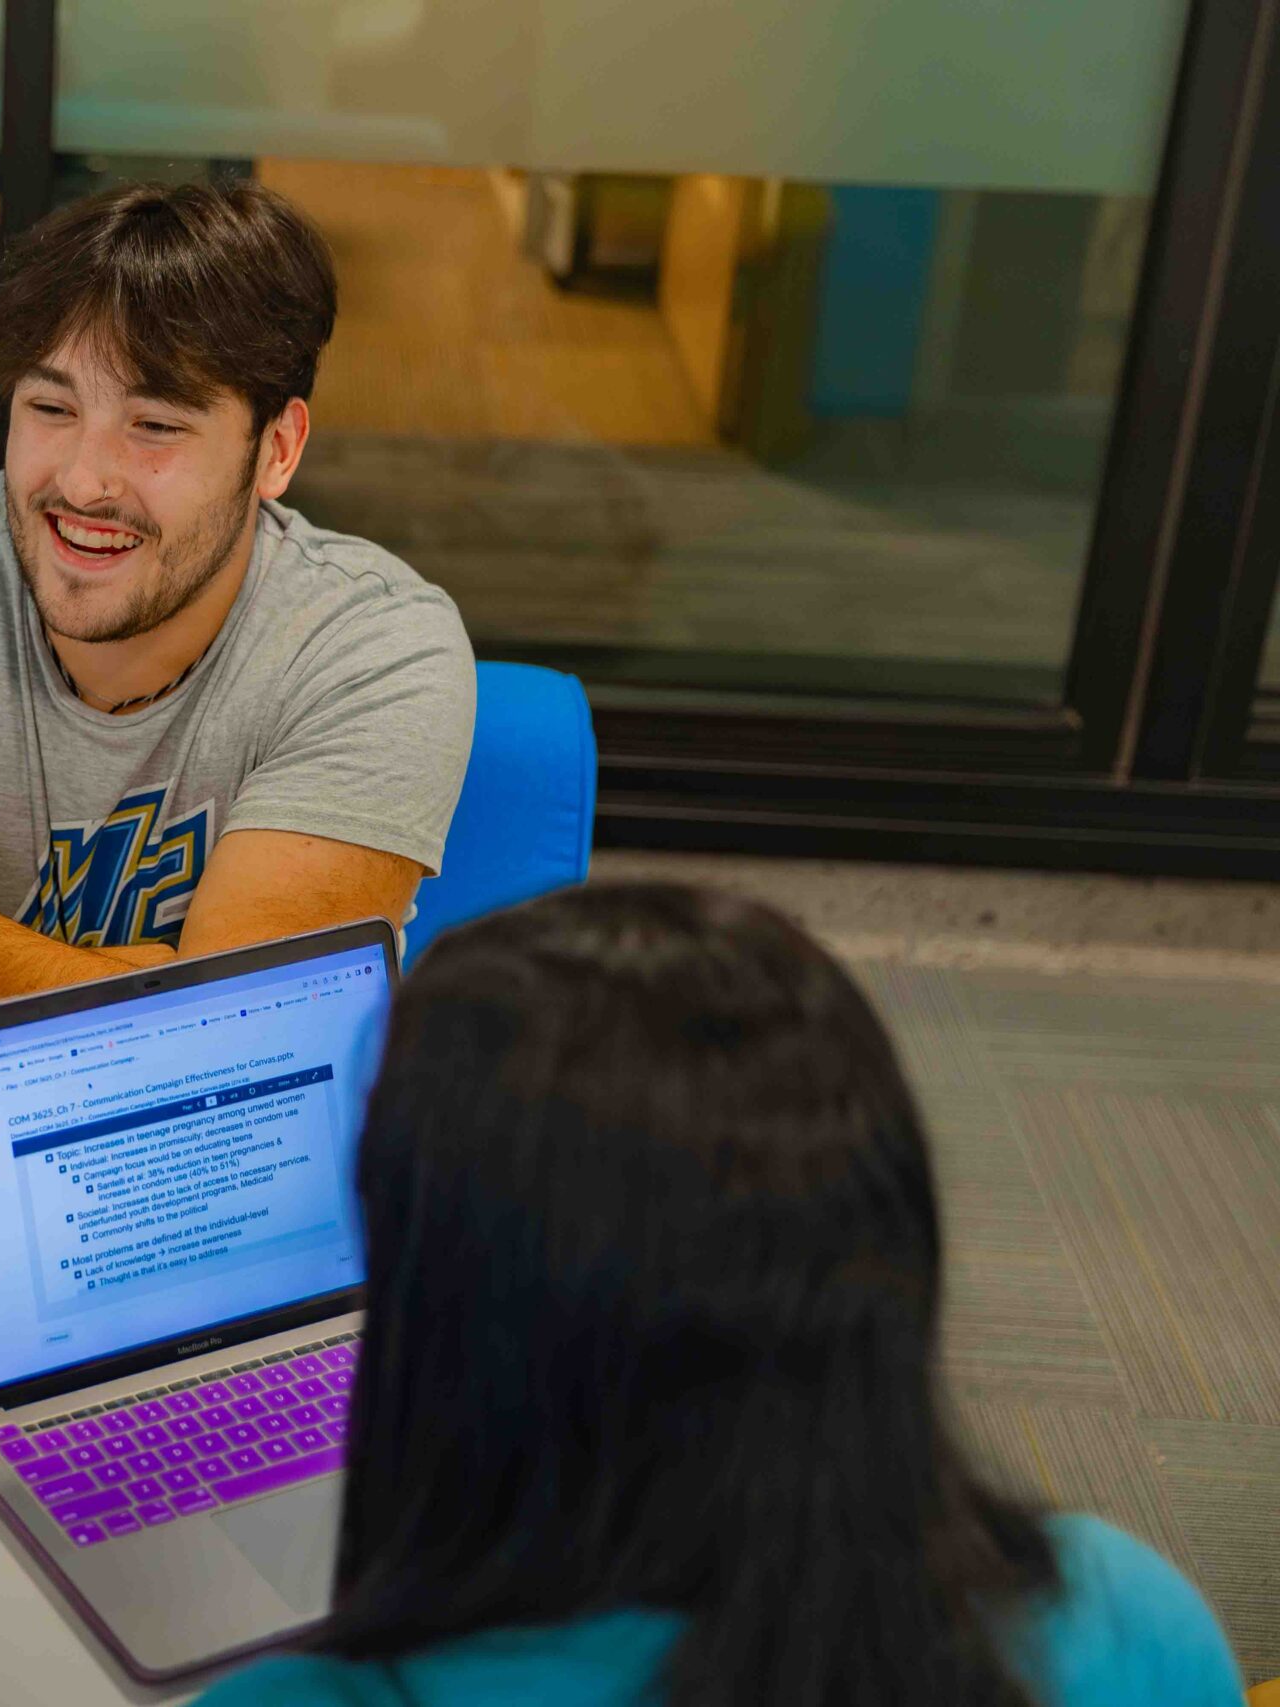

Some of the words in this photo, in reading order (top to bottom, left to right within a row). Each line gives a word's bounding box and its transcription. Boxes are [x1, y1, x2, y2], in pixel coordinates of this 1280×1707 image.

[8, 1114, 30, 1126] COM
[32, 1105, 68, 1120] 3625_Ch
[69, 1102, 75, 1111] 7
[82, 1088, 143, 1107] Communication
[145, 1079, 183, 1092] Campaign
[185, 1066, 234, 1083] Effectiveness
[248, 1052, 293, 1067] Canvas.pptx
[88, 1107, 129, 1120] Communication
[129, 1100, 156, 1109] Campaign
[156, 1092, 190, 1103] Effectiveness
[56, 1149, 80, 1159] Topic:
[84, 1138, 124, 1152] Increases
[126, 1135, 134, 1143] in
[136, 1126, 170, 1140] teenage
[172, 1116, 215, 1132] pregnancy
[217, 1107, 245, 1120] among
[247, 1099, 274, 1112] unwed
[275, 1093, 305, 1105] women
[70, 1155, 107, 1170] Individual:
[111, 1146, 147, 1159] Increases
[158, 1132, 202, 1149] promiscuity;
[205, 1122, 243, 1136] decreases
[253, 1112, 283, 1124] condom
[284, 1108, 298, 1117] use
[83, 1166, 123, 1180] Campaign
[124, 1160, 145, 1169] focus
[147, 1152, 169, 1164] would
[182, 1148, 192, 1156] on
[194, 1138, 230, 1152] educating
[232, 1133, 252, 1142] teens
[97, 1177, 125, 1190] Santelli
[126, 1175, 134, 1183] et
[147, 1167, 164, 1177] 38%
[166, 1159, 201, 1172] reduction
[202, 1156, 210, 1167] in
[211, 1152, 228, 1163] teen
[229, 1140, 274, 1159] pregnancies
[276, 1137, 282, 1145] &
[98, 1187, 130, 1200] increase
[141, 1177, 171, 1189] condom
[173, 1173, 187, 1181] use
[189, 1166, 208, 1178] (40%
[219, 1158, 239, 1169] 51%)
[77, 1205, 108, 1219] Societal:
[112, 1196, 149, 1210] Increases
[150, 1192, 165, 1201] due
[166, 1189, 175, 1199] to
[176, 1184, 191, 1194] lack
[193, 1180, 200, 1190] of
[202, 1175, 228, 1187] access
[230, 1172, 238, 1180] to
[239, 1163, 276, 1180] necessary
[79, 1211, 126, 1229] underfunded
[128, 1205, 149, 1218] youth
[151, 1192, 199, 1210] development
[201, 1184, 238, 1199] programs,
[240, 1173, 273, 1187] Medicaid
[71, 1254, 93, 1265] Most
[95, 1244, 133, 1261] problems
[135, 1240, 149, 1249] are
[151, 1230, 182, 1245] defined
[184, 1227, 192, 1236] at
[193, 1224, 207, 1233] the
[209, 1208, 268, 1229] individual-level
[92, 1224, 133, 1239] Commonly
[135, 1218, 155, 1228] shifts
[156, 1215, 164, 1223] to
[165, 1212, 178, 1220] the
[180, 1203, 208, 1218] political
[85, 1265, 103, 1276] Lack
[105, 1261, 113, 1271] of
[115, 1252, 155, 1267] knowledge
[168, 1240, 199, 1253] increase
[201, 1229, 241, 1245] awareness
[99, 1271, 131, 1286] Thought
[140, 1264, 156, 1275] that
[156, 1262, 167, 1271] it's
[169, 1257, 187, 1267] easy
[188, 1254, 197, 1262] to
[198, 1246, 228, 1259] address
[177, 1341, 210, 1355] MacBook
[210, 1336, 223, 1345] Pro
